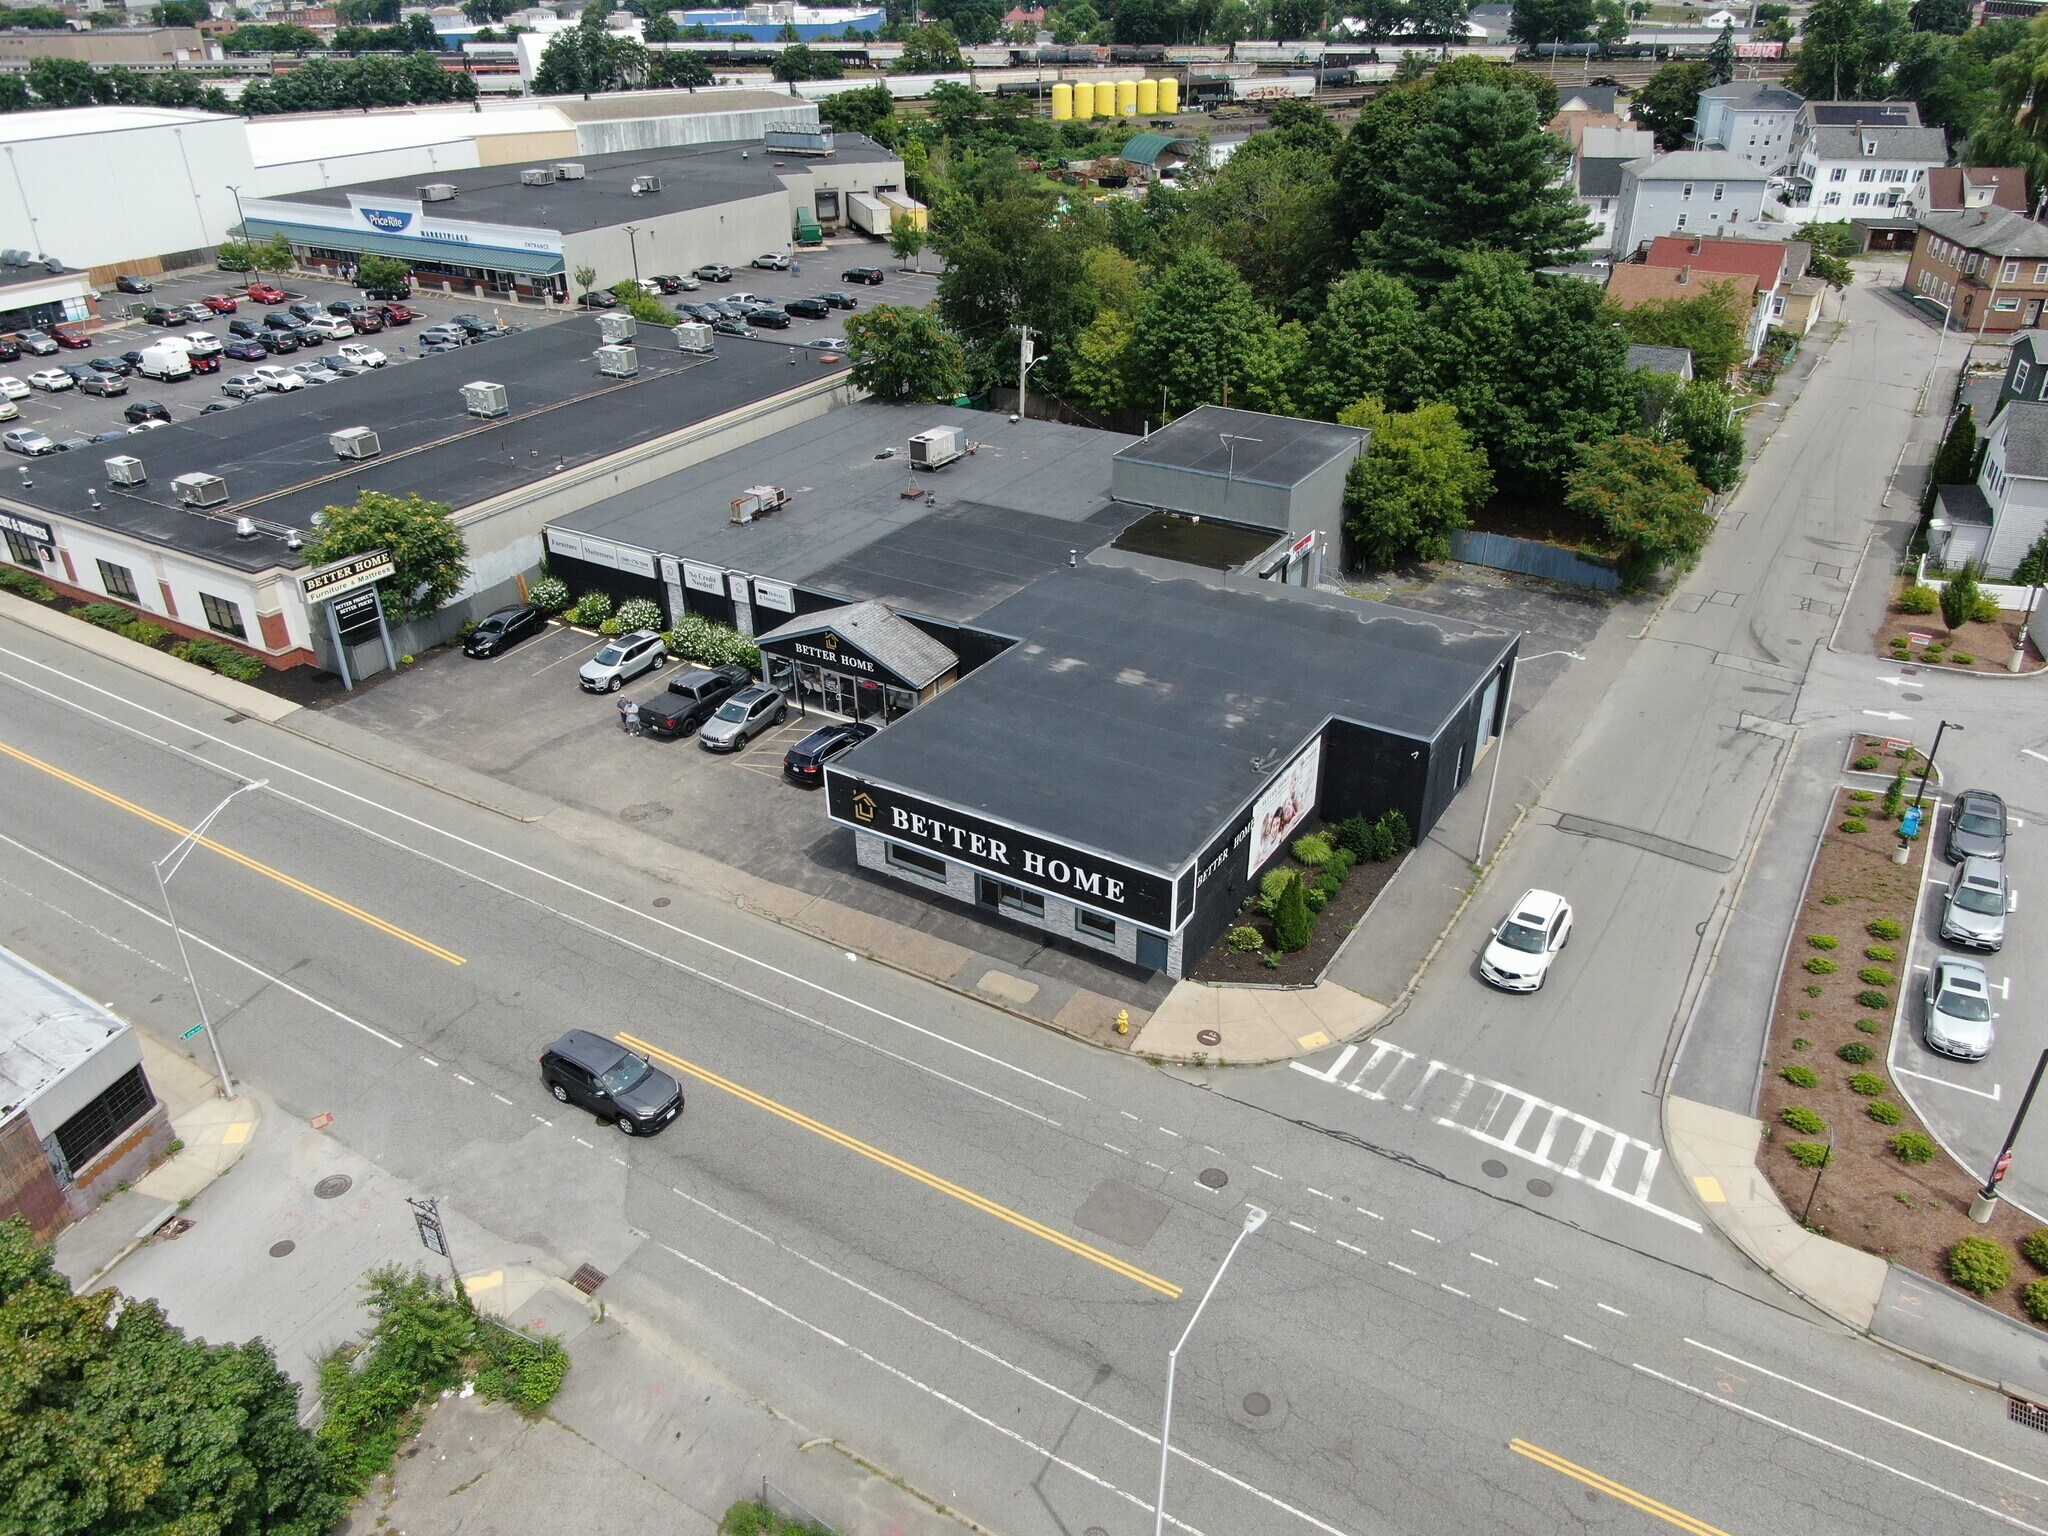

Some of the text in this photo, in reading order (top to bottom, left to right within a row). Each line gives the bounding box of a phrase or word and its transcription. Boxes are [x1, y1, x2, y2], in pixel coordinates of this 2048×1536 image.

[369, 212, 403, 228] PriceRite
[420, 230, 469, 242] MARKETPLACE
[524, 242, 549, 250] ENTRANCE
[551, 538, 578, 551] Furniture
[306, 553, 389, 590] BETTER HOME
[688, 570, 698, 579] No
[698, 572, 716, 583] Credit
[310, 584, 348, 601] Furniture
[357, 567, 391, 583] Mattress
[692, 578, 715, 590] Needed!
[335, 600, 353, 610] BETTER
[340, 605, 358, 614] BETTER
[795, 642, 874, 672] BETTER HOME
[890, 806, 1125, 903] BETTER HOME
[1197, 817, 1254, 888] BETTER HOME
